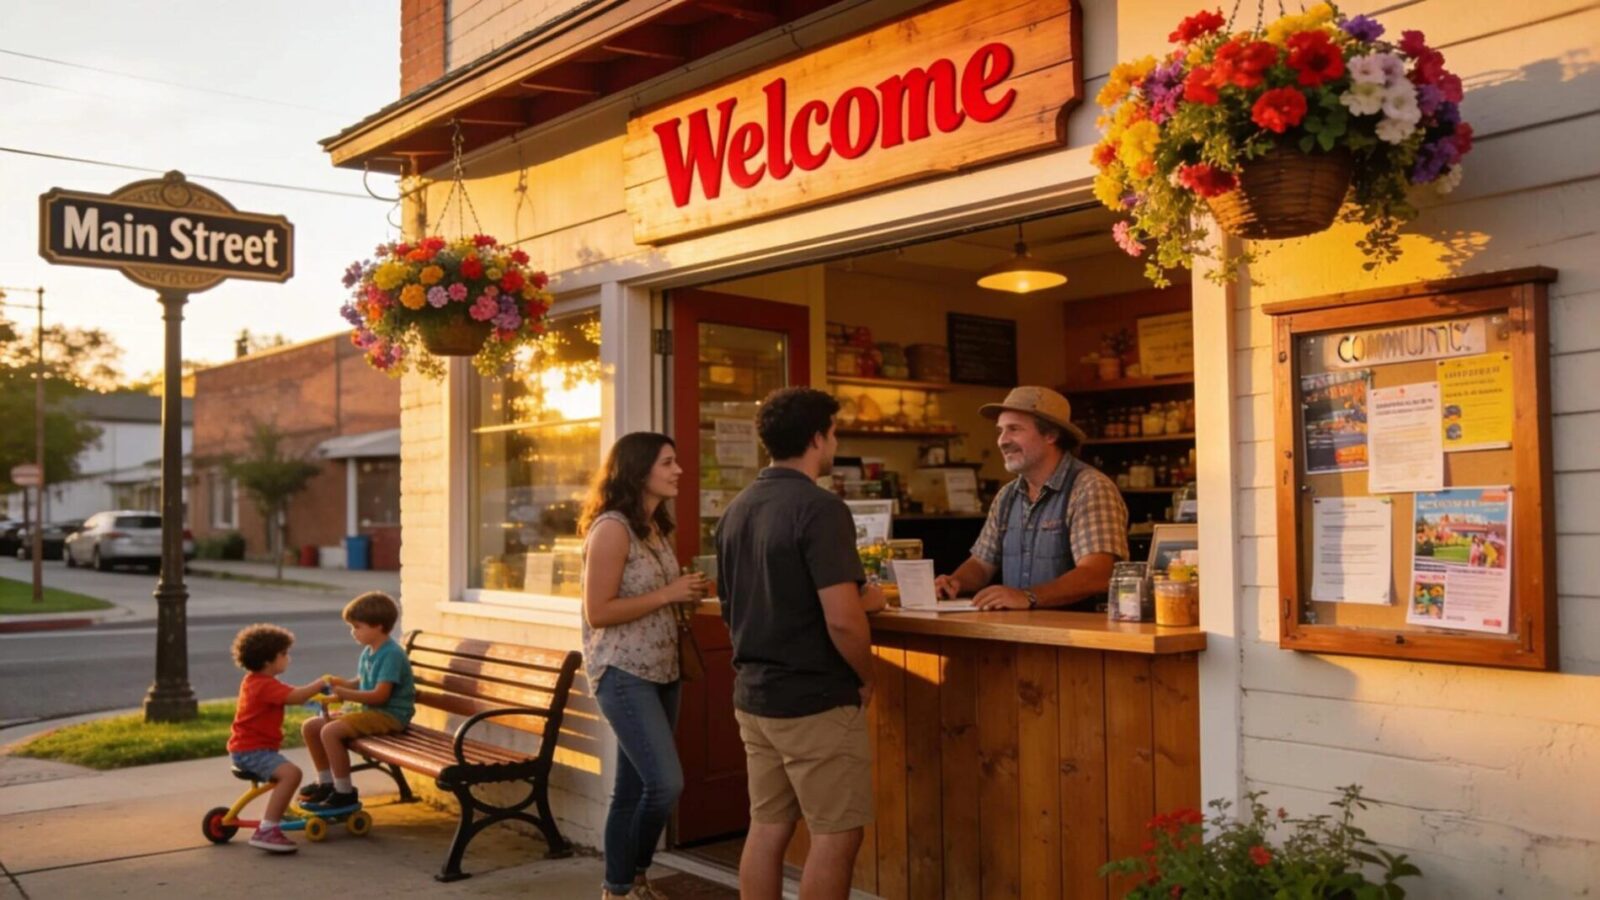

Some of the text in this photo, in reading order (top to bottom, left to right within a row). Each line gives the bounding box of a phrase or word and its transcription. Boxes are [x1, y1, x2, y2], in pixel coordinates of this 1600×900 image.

[653, 42, 1016, 208] Welcome
[63, 205, 279, 268] Main Street
